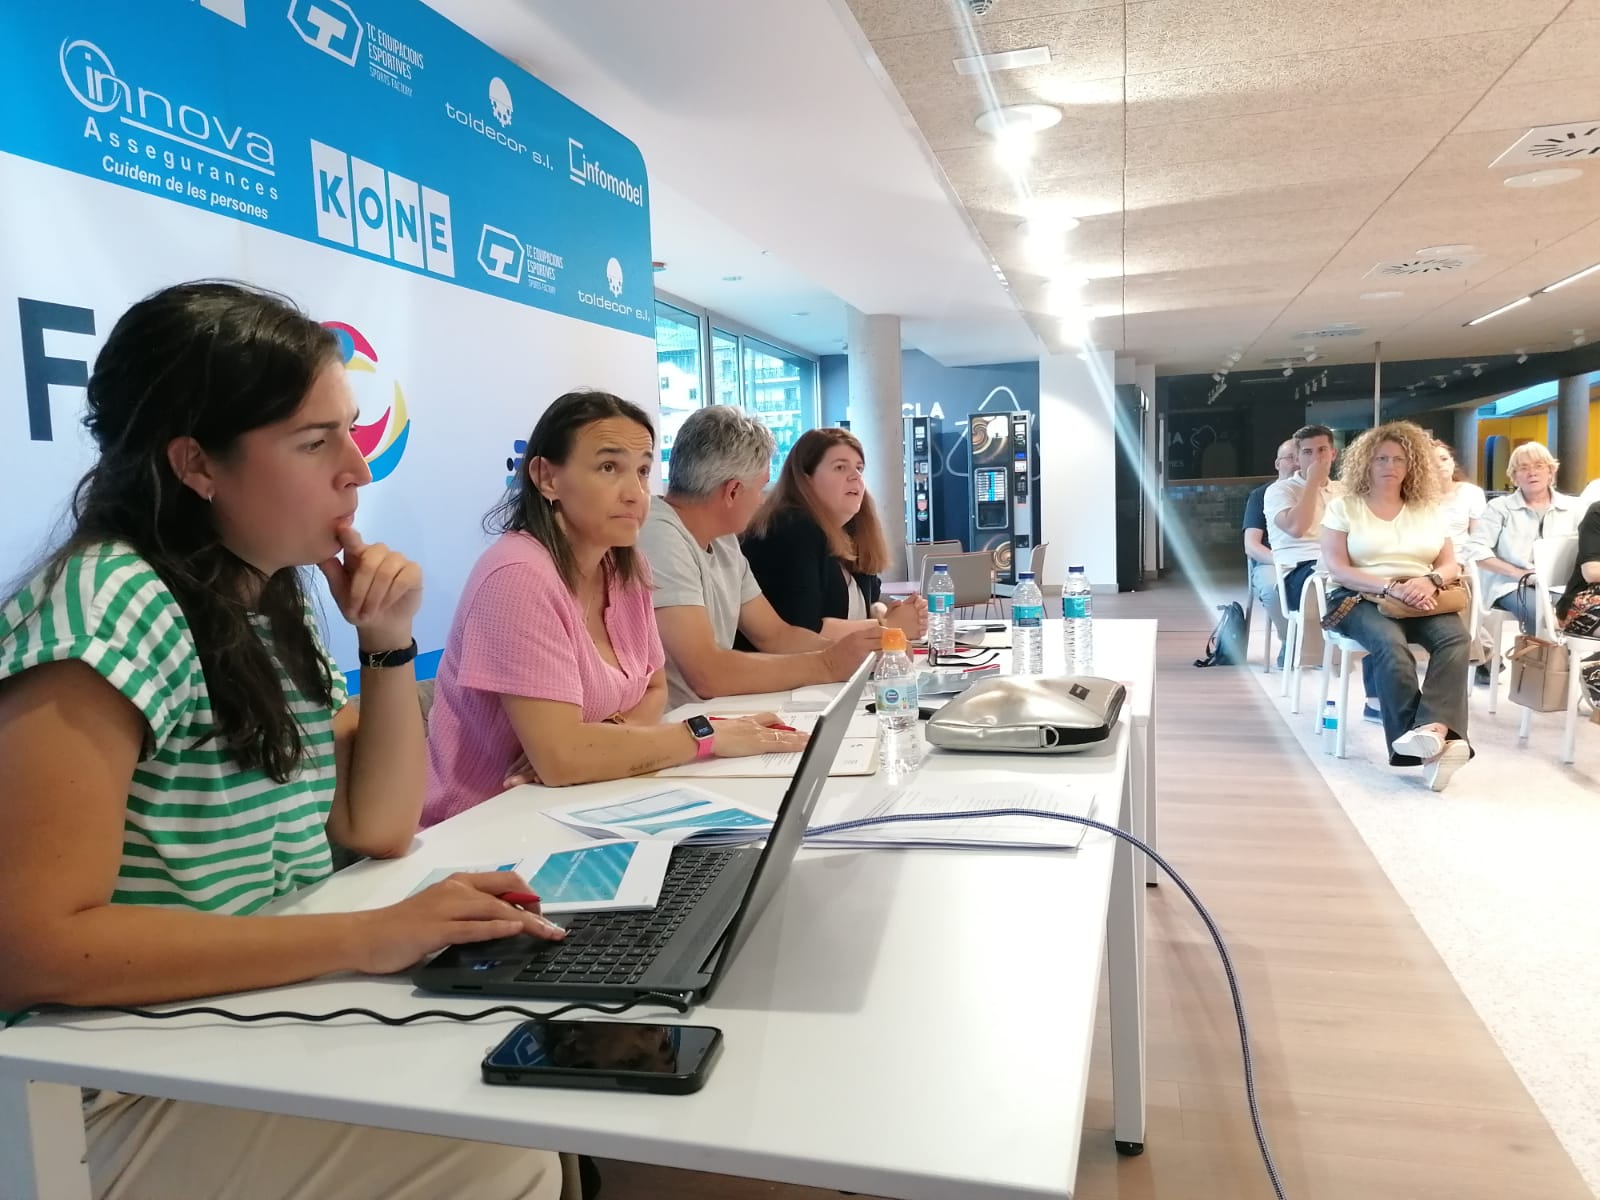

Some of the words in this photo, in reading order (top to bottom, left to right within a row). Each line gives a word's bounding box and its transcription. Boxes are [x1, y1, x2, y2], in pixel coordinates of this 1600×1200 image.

[366, 22, 376, 41] TC
[377, 28, 424, 70] EQUIPACIONS
[368, 42, 412, 80] ESPORTIVES
[84, 53, 275, 166] innova
[445, 101, 528, 155] toldecor
[84, 116, 279, 200] Assegurances
[582, 153, 643, 207] infomobel
[102, 155, 161, 187] Cuidem
[165, 176, 183, 193] de
[187, 181, 207, 201] les
[210, 191, 269, 220] persones
[318, 169, 449, 253] KONE
[578, 290, 632, 316] toldecor
